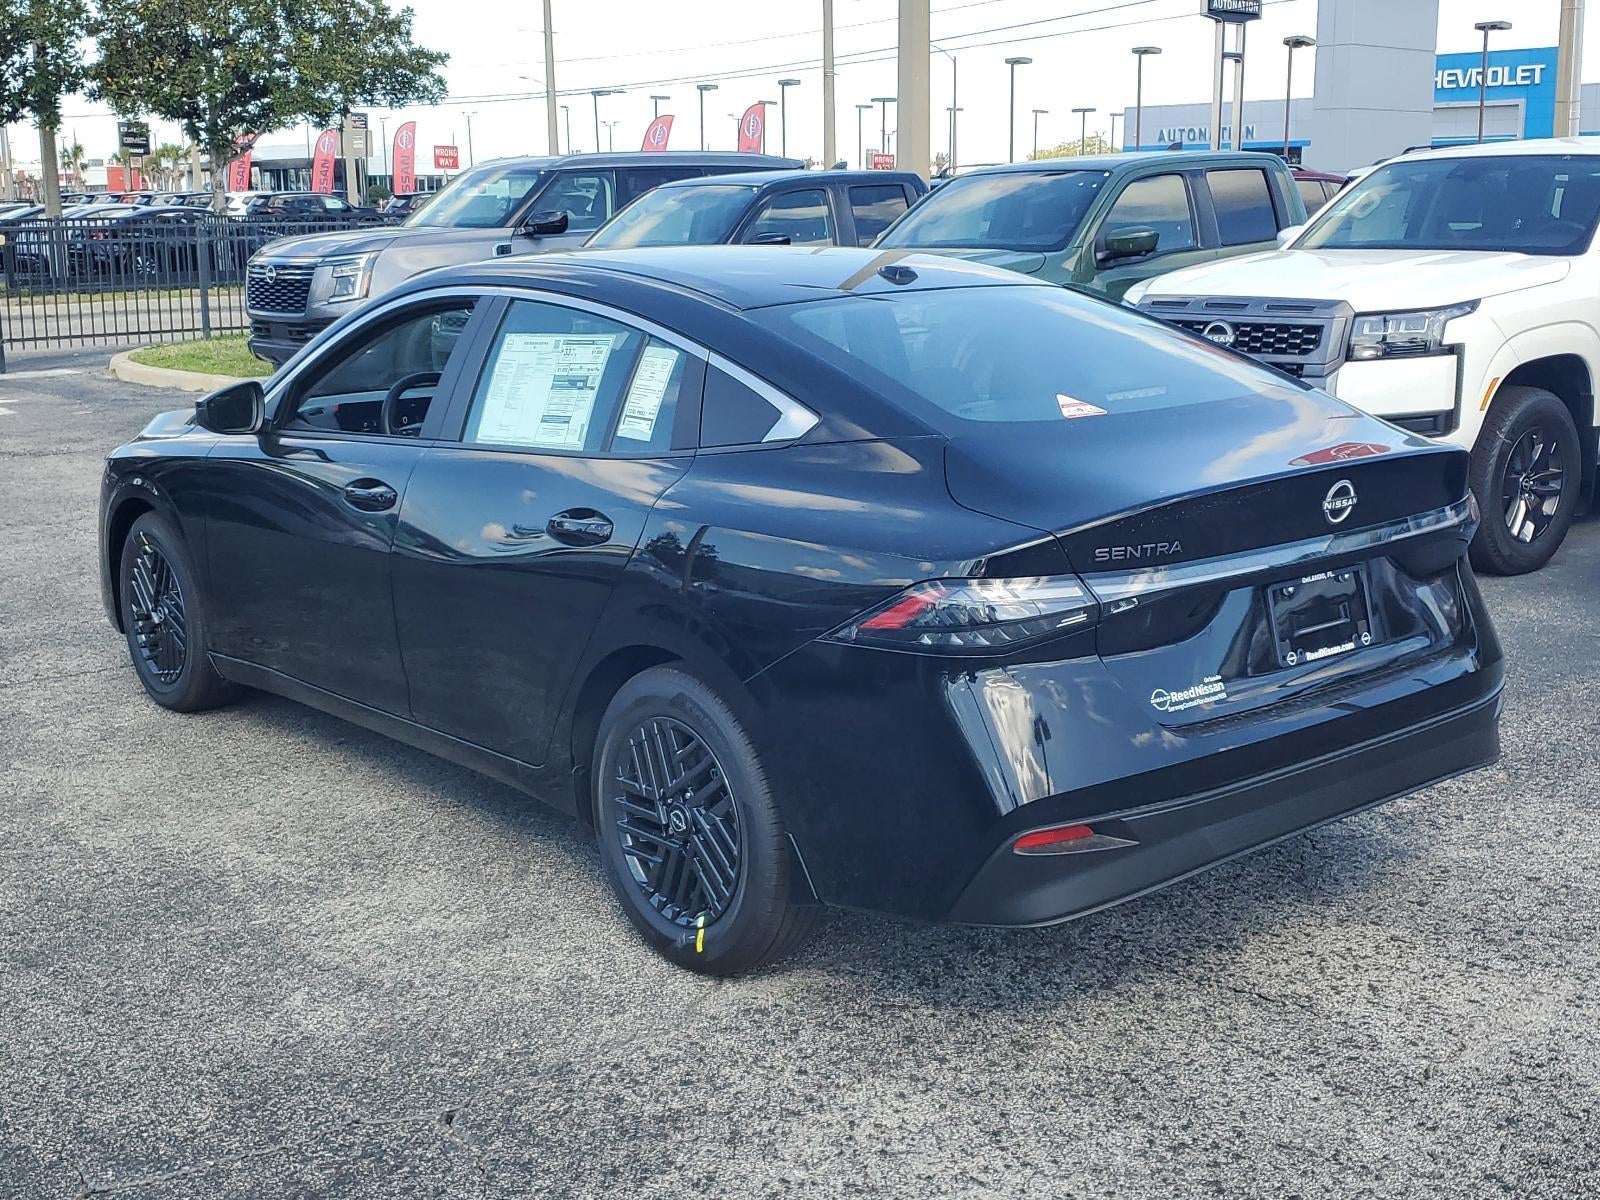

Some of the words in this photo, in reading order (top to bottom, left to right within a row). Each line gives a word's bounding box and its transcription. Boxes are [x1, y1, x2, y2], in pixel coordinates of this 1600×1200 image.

[1212, 0, 1260, 12] AUTONATION
[1434, 64, 1546, 89] HEVROLET
[1157, 125, 1256, 143] AUTONTIN
[435, 148, 458, 157] WRONG
[439, 158, 454, 167] WAY
[236, 160, 245, 192] SSAN
[319, 159, 329, 192] SSAN
[401, 155, 411, 193] SSAN
[1323, 496, 1358, 511] NISSAN
[1095, 541, 1183, 561] SENTRA
[1305, 641, 1355, 661] ReedNissan.com
